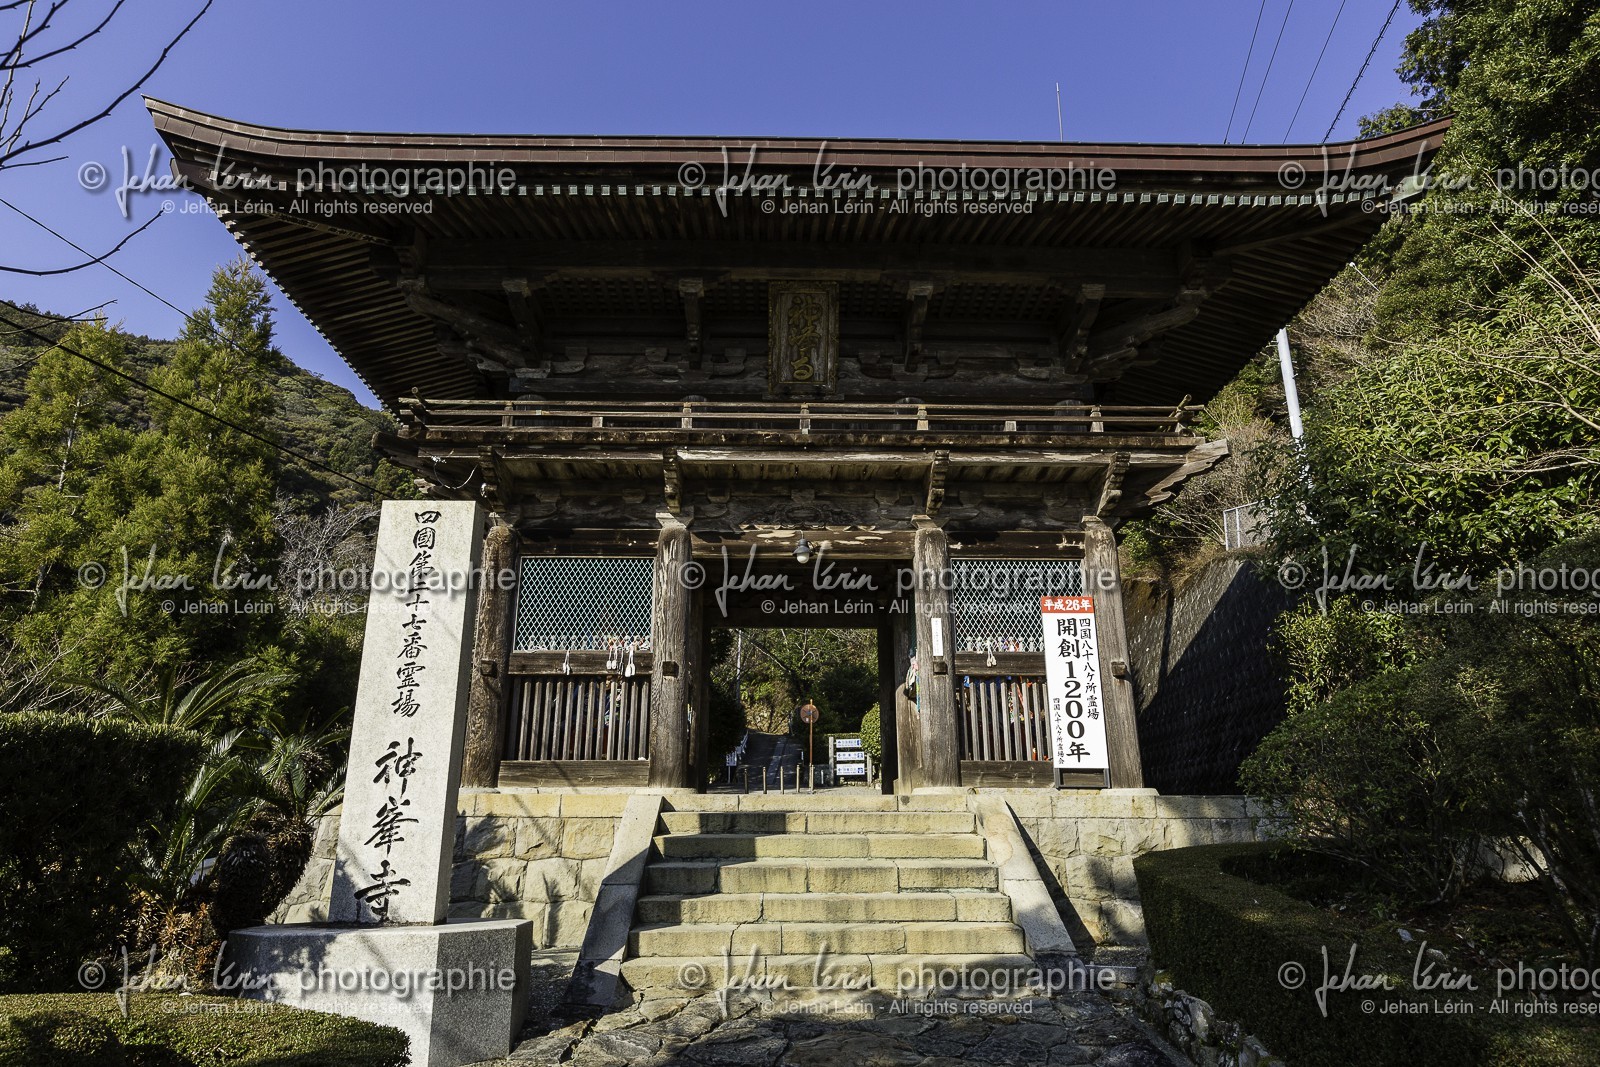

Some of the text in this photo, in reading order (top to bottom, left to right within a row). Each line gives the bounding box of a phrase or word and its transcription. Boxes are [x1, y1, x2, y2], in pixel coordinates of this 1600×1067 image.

[1043, 599, 1092, 611] 平成26年
[1057, 617, 1091, 763] 開創1200年
